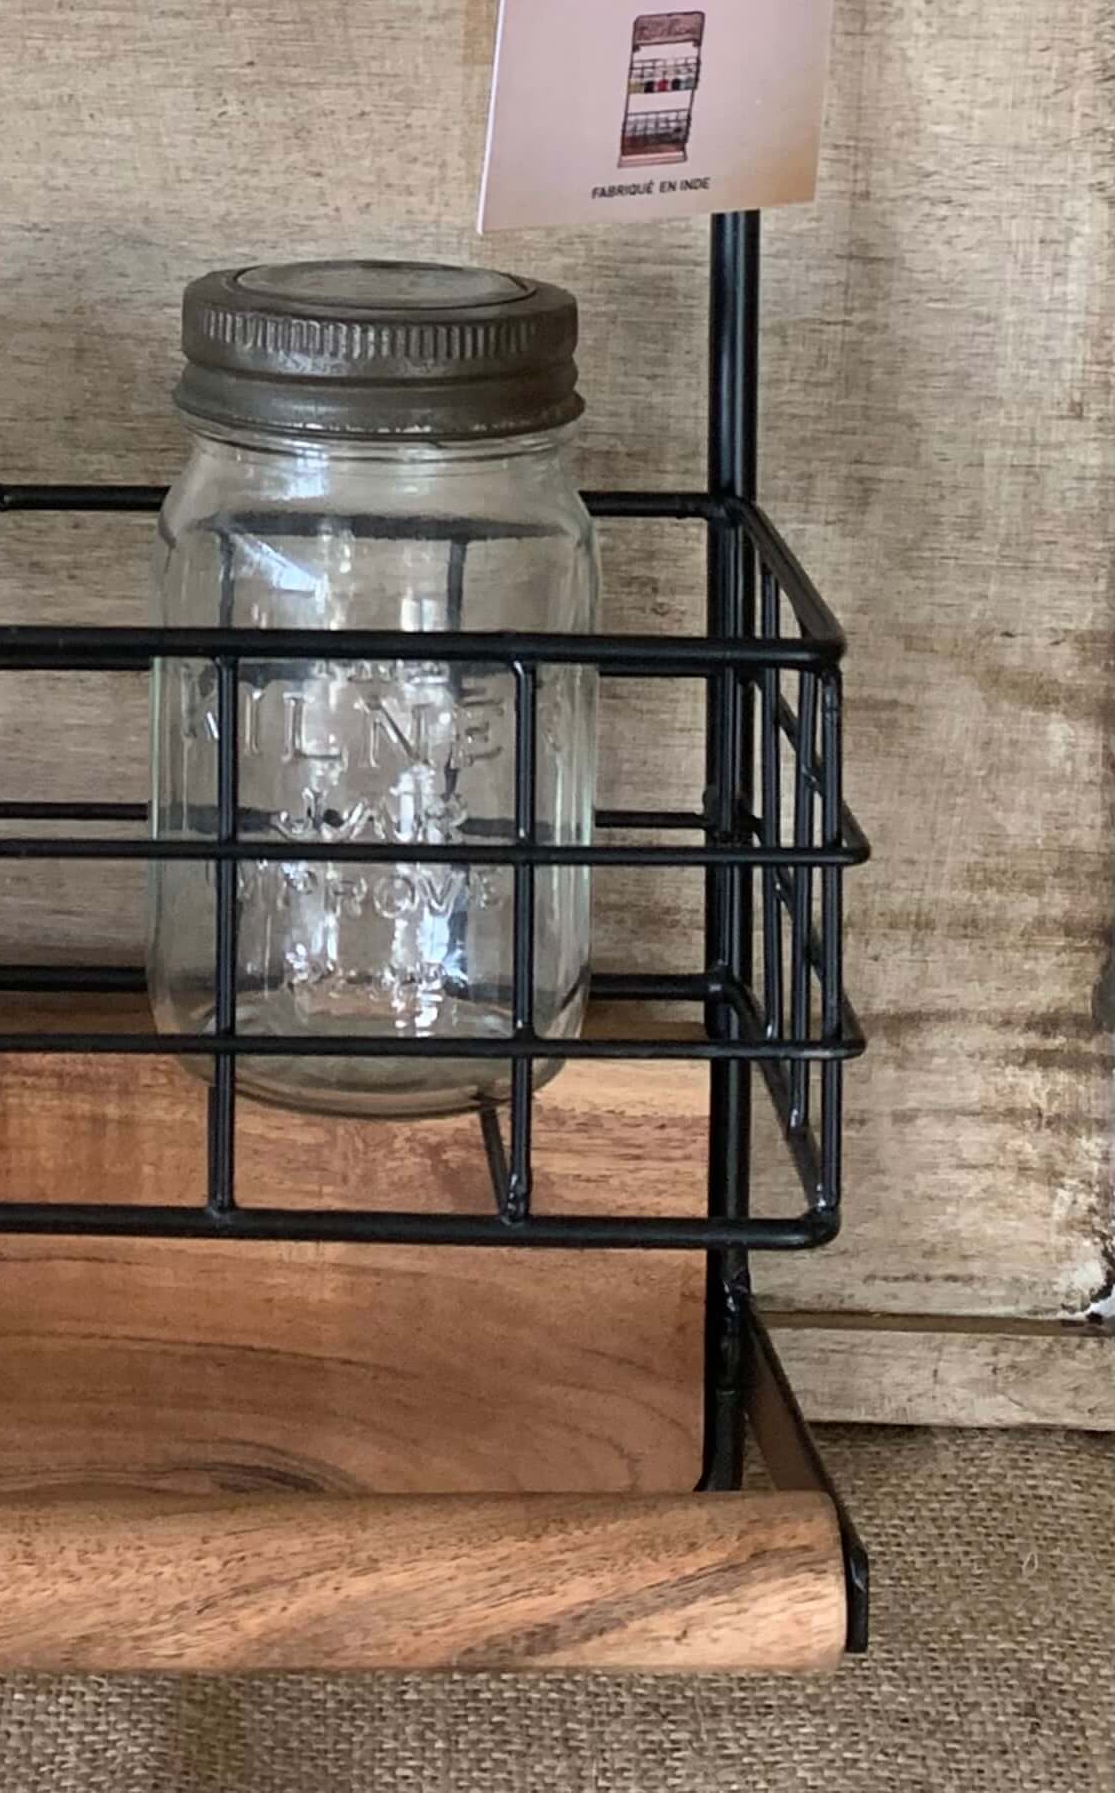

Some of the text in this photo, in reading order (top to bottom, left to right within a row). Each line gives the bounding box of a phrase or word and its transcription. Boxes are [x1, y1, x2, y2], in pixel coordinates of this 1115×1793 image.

[591, 177, 712, 199] FABRIQUÉ EN INDE
